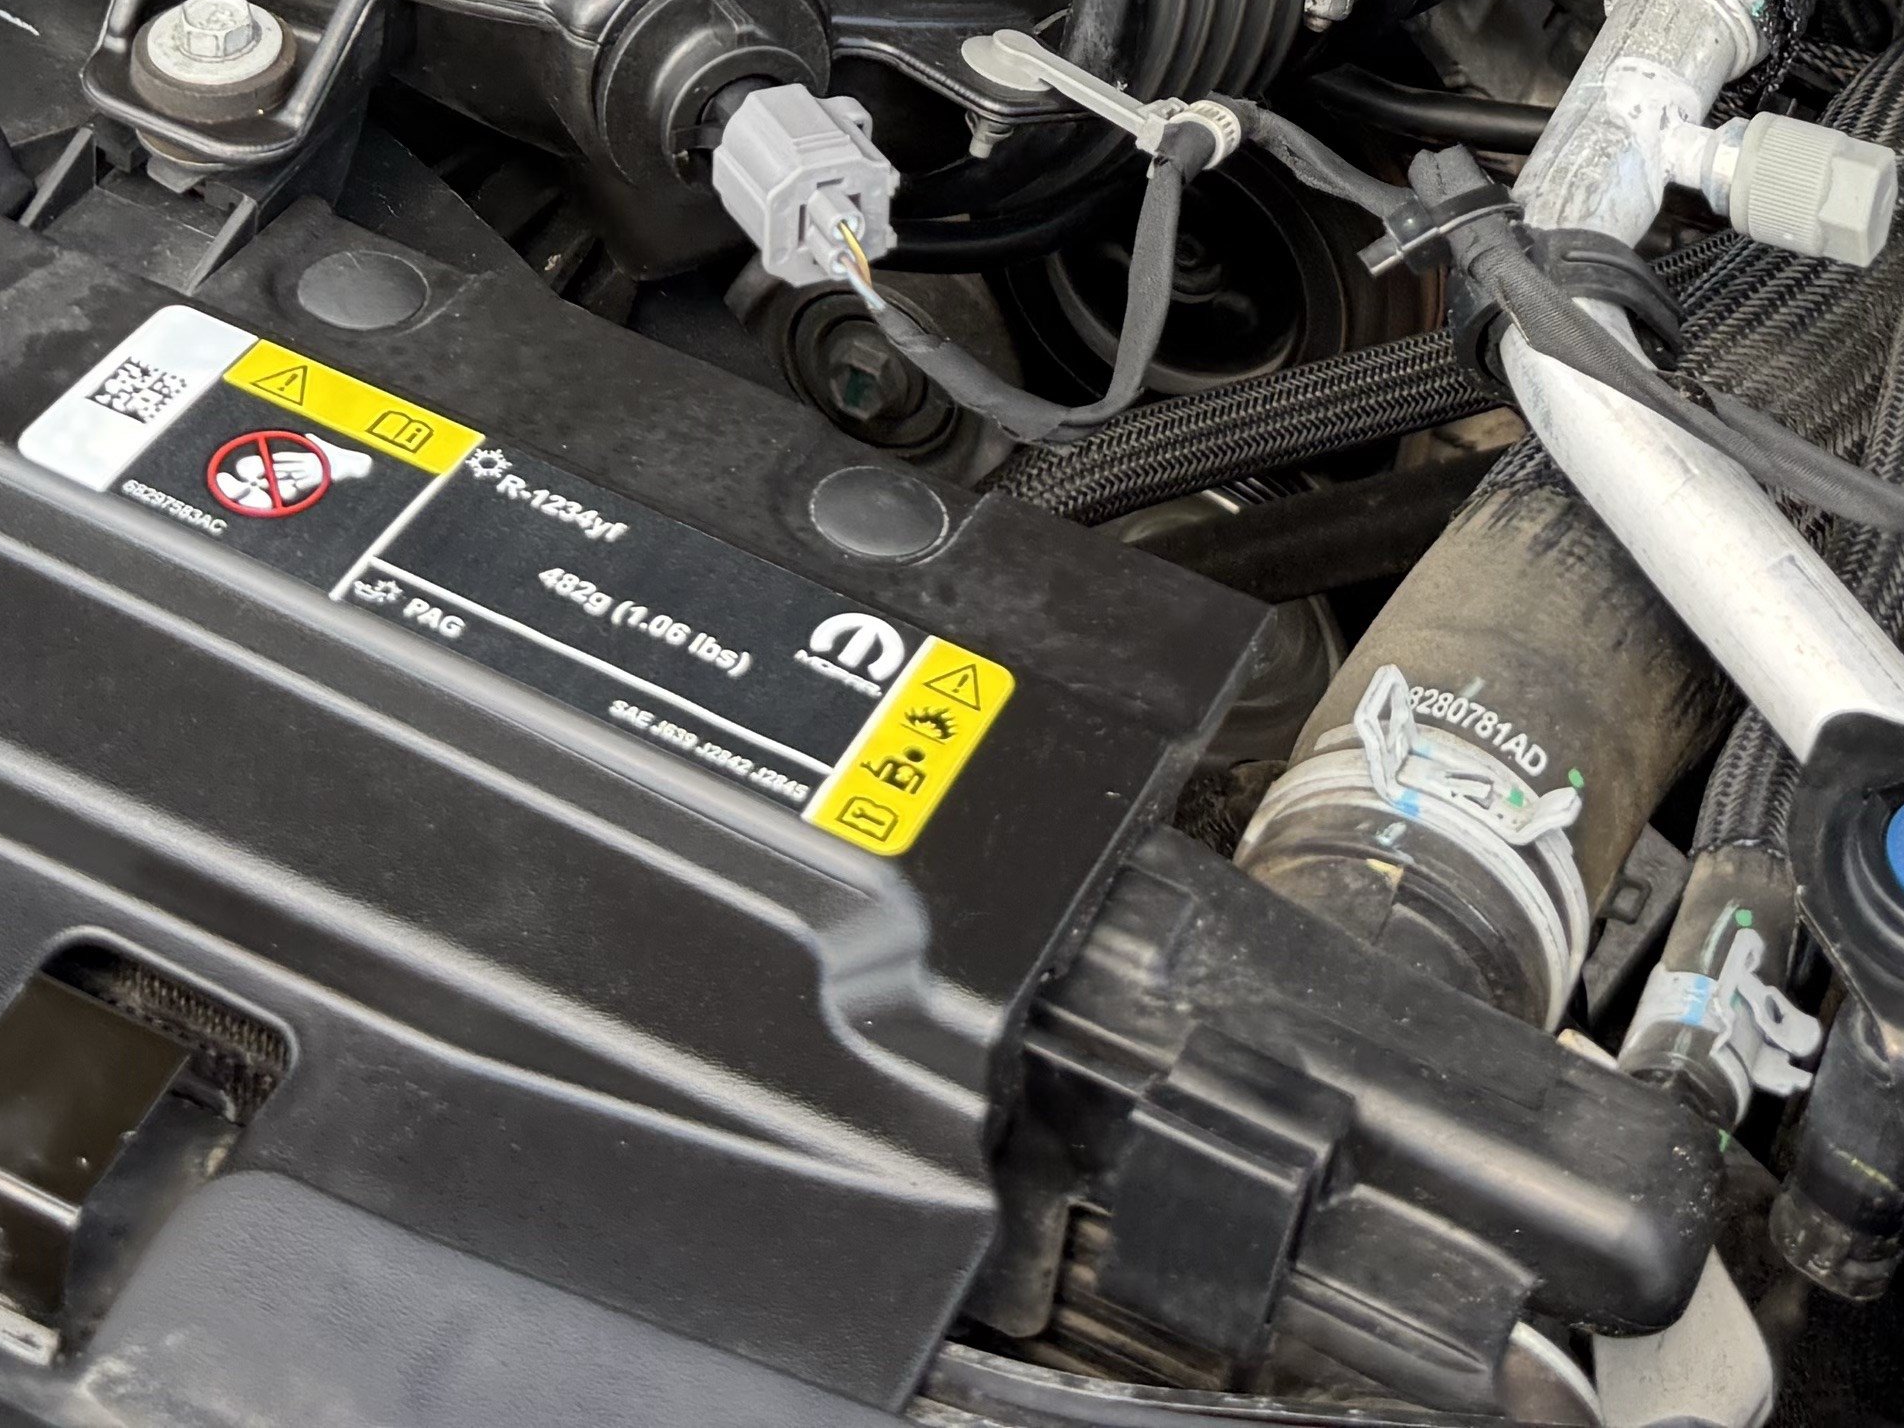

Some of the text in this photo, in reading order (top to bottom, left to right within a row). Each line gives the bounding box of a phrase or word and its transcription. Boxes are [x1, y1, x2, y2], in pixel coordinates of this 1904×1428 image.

[497, 474, 630, 543] R-1234yf
[402, 597, 467, 639] PAG
[538, 567, 753, 679] 482g (1.06 lbs)
[607, 700, 655, 729] SAE
